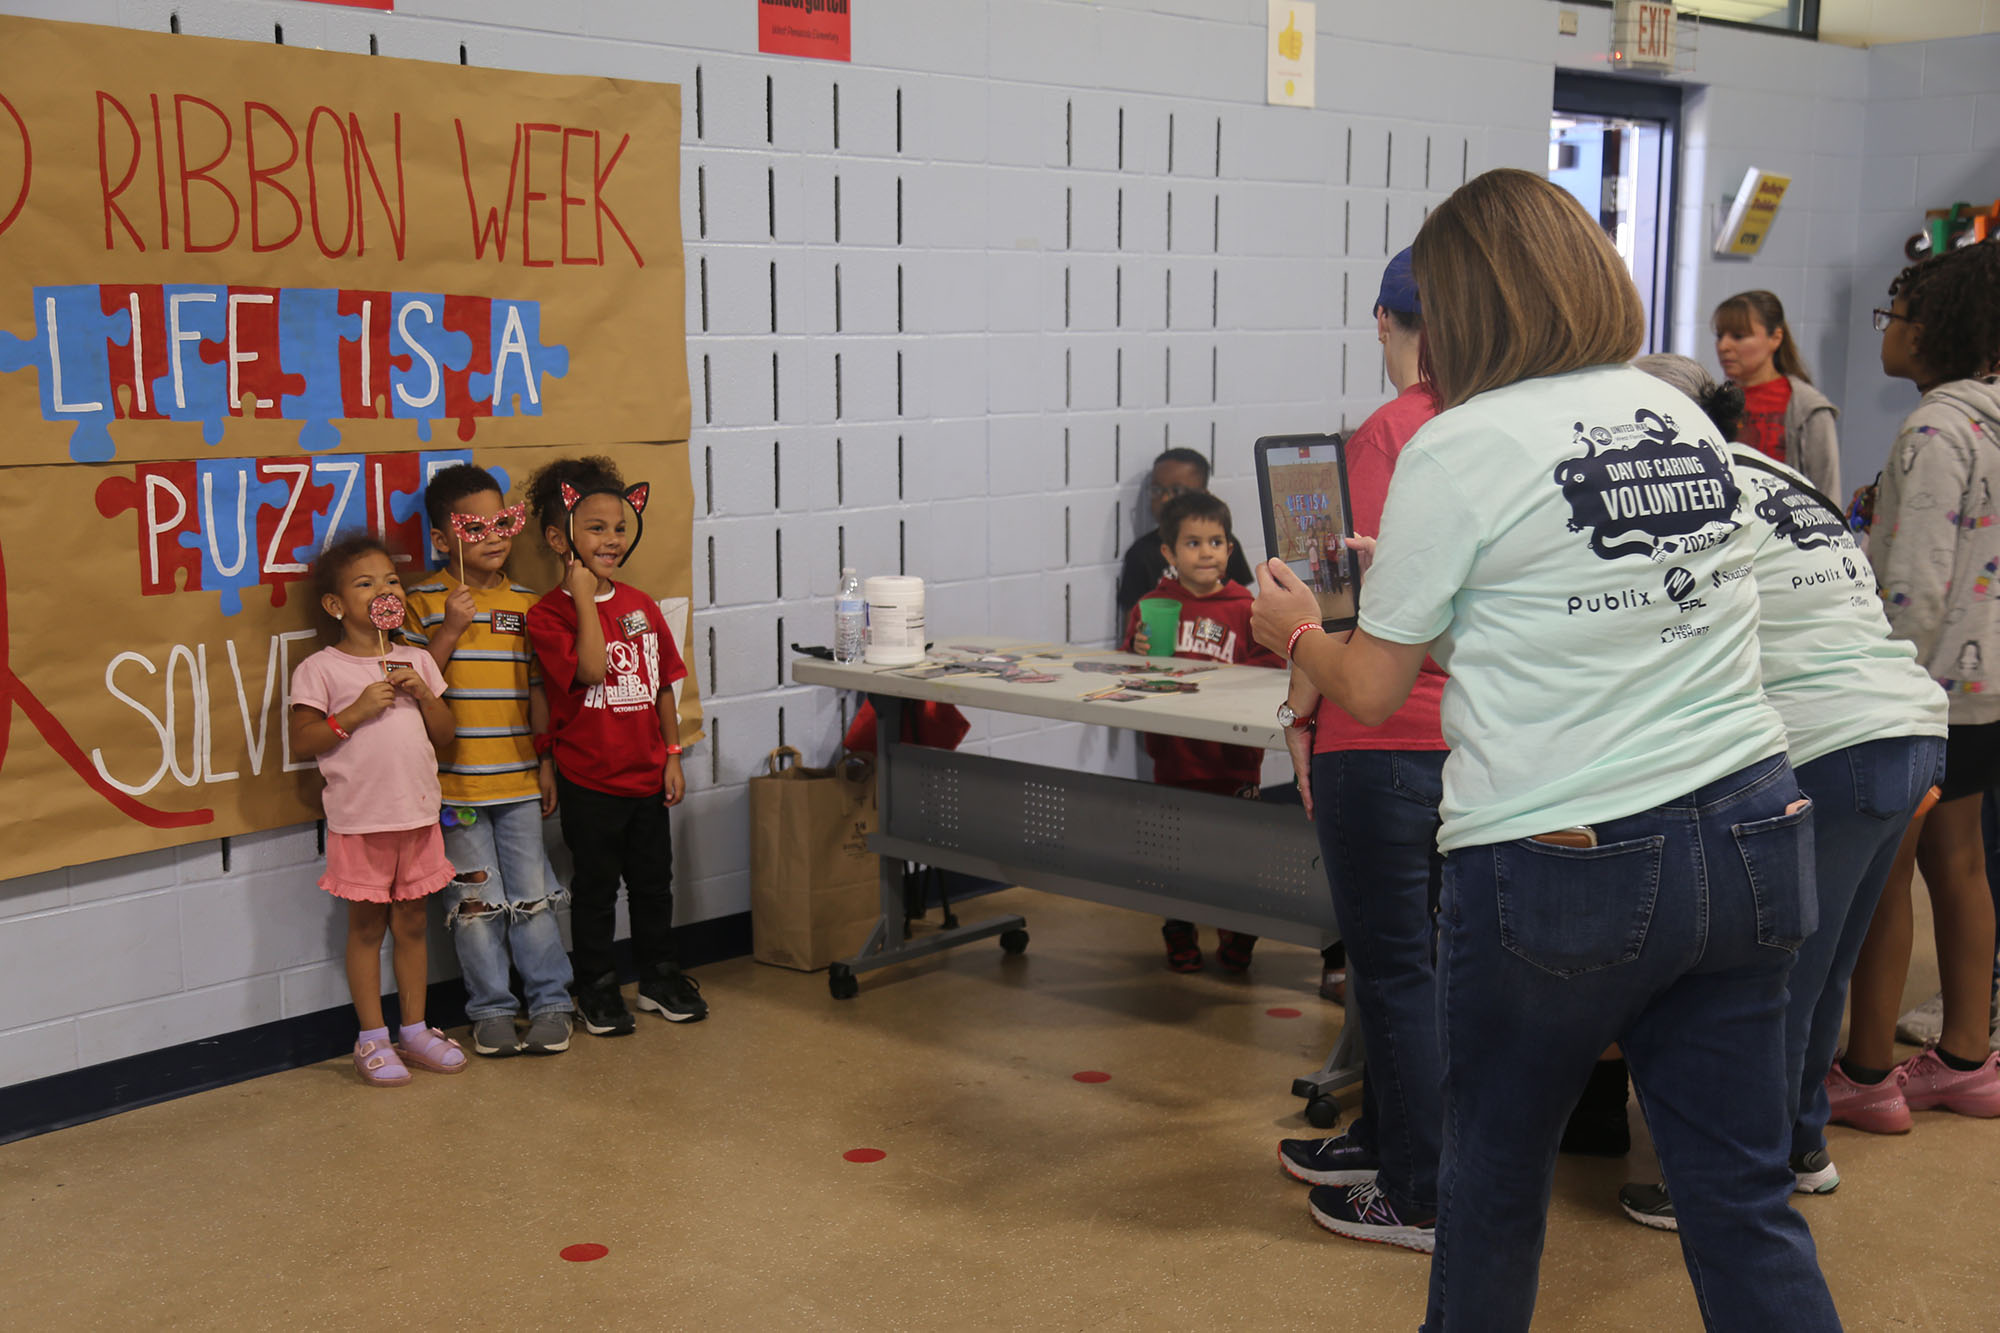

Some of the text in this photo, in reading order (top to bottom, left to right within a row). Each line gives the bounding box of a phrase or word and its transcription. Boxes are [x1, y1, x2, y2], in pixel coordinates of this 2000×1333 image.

[1638, 5, 1671, 57] EXIT
[96, 90, 406, 262] RIBBON
[455, 118, 645, 268] WEEK
[46, 293, 540, 413] LIFE IS A
[1610, 423, 1635, 435] UNITED
[1604, 456, 1706, 483] DAY OF CARING
[1599, 478, 1726, 521] VOLUNTEER
[145, 459, 465, 585] PUZZL
[1679, 532, 1716, 555] 2025
[1791, 568, 1841, 590] Publix
[1567, 589, 1651, 615] Publix
[1678, 598, 1708, 614] FPL
[617, 674, 641, 685] RED
